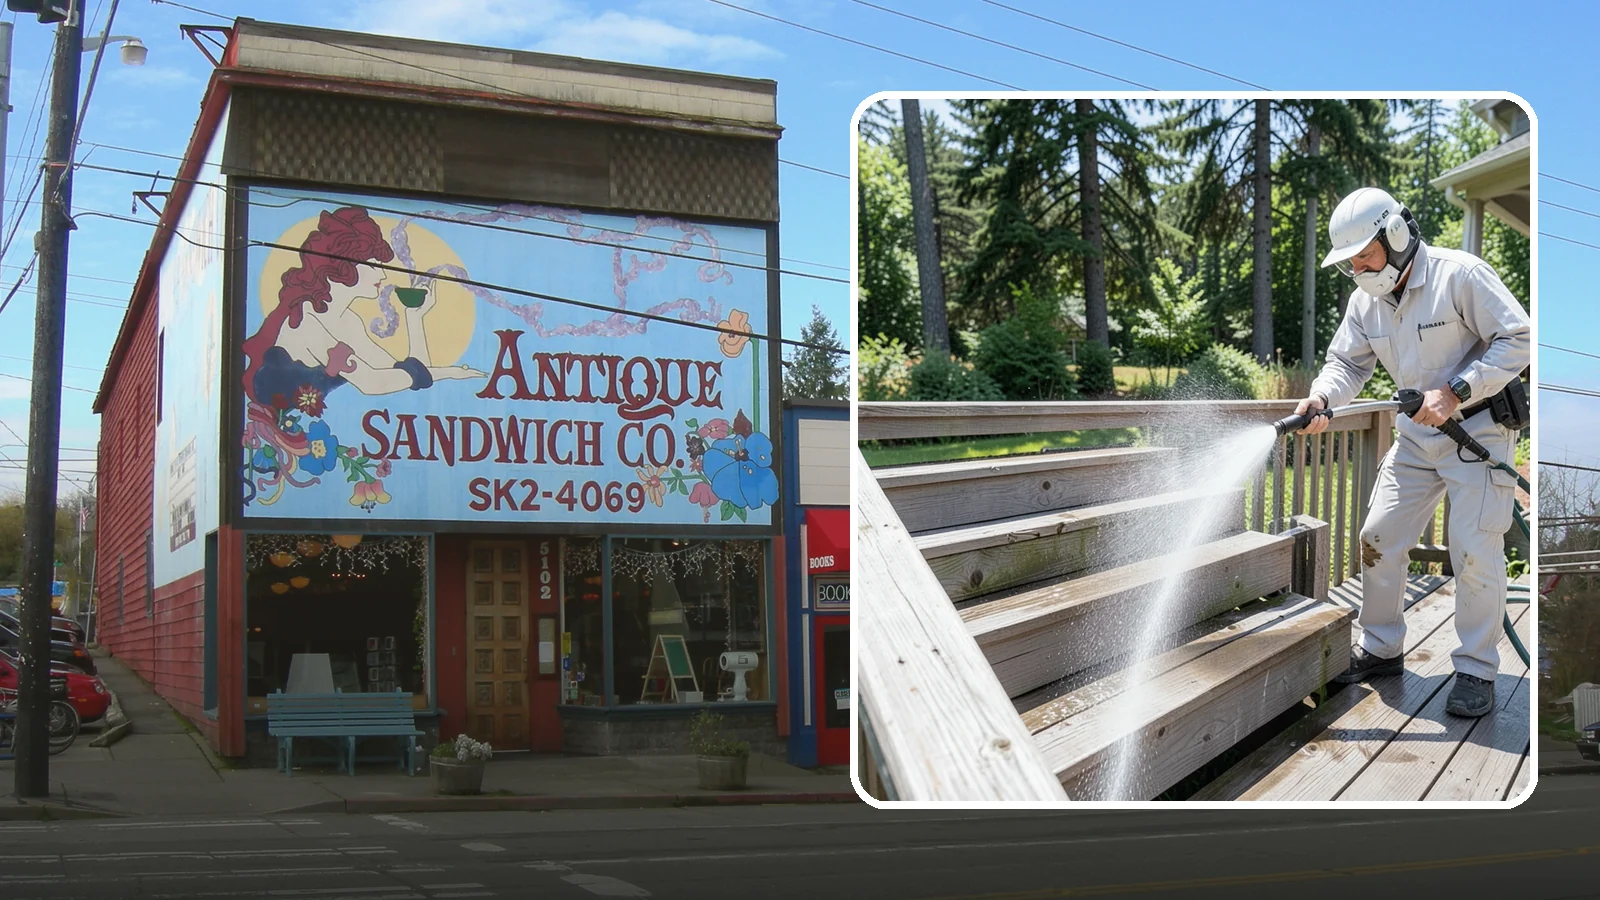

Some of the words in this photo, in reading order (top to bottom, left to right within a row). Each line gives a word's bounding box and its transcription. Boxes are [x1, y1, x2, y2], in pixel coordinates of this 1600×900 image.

[476, 329, 723, 420] ANTIQUE
[361, 409, 604, 467] SANDWICH
[617, 421, 685, 468] CO.
[468, 477, 646, 513] SK2-4069
[539, 541, 552, 600] 5102
[809, 555, 835, 569] BOOKS
